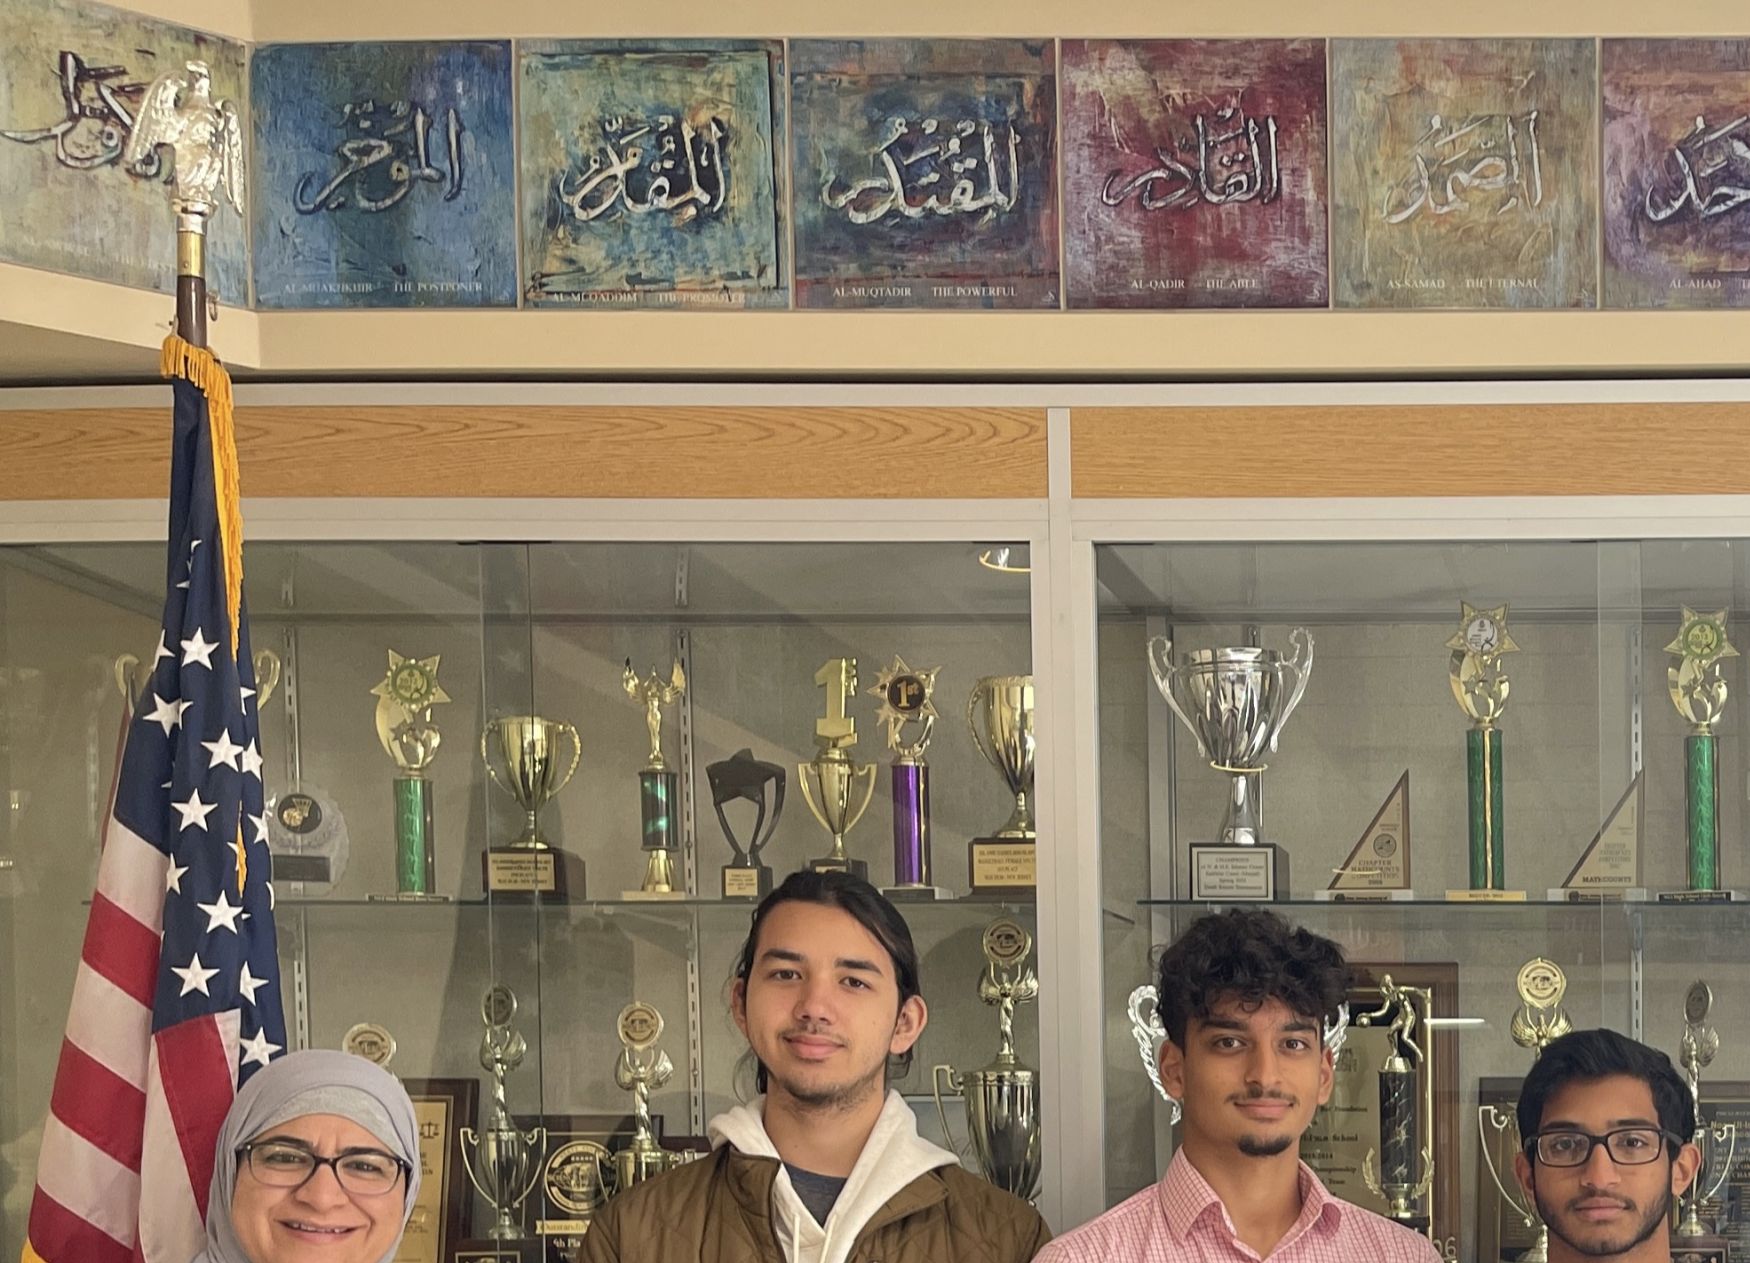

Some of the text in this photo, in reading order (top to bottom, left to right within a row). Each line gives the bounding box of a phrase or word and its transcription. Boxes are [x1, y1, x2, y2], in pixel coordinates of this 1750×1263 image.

[394, 282, 412, 292] THE
[1131, 279, 1258, 290] AL-QADIR THE ABLE
[1387, 279, 1445, 289] AS-SAMAD
[1466, 279, 1486, 288] THE
[1669, 279, 1721, 289] AL-AHAD
[833, 286, 1017, 298] AL-MUQTADIR THE POWERFUL
[658, 293, 676, 302] THE
[897, 680, 919, 707] 1st
